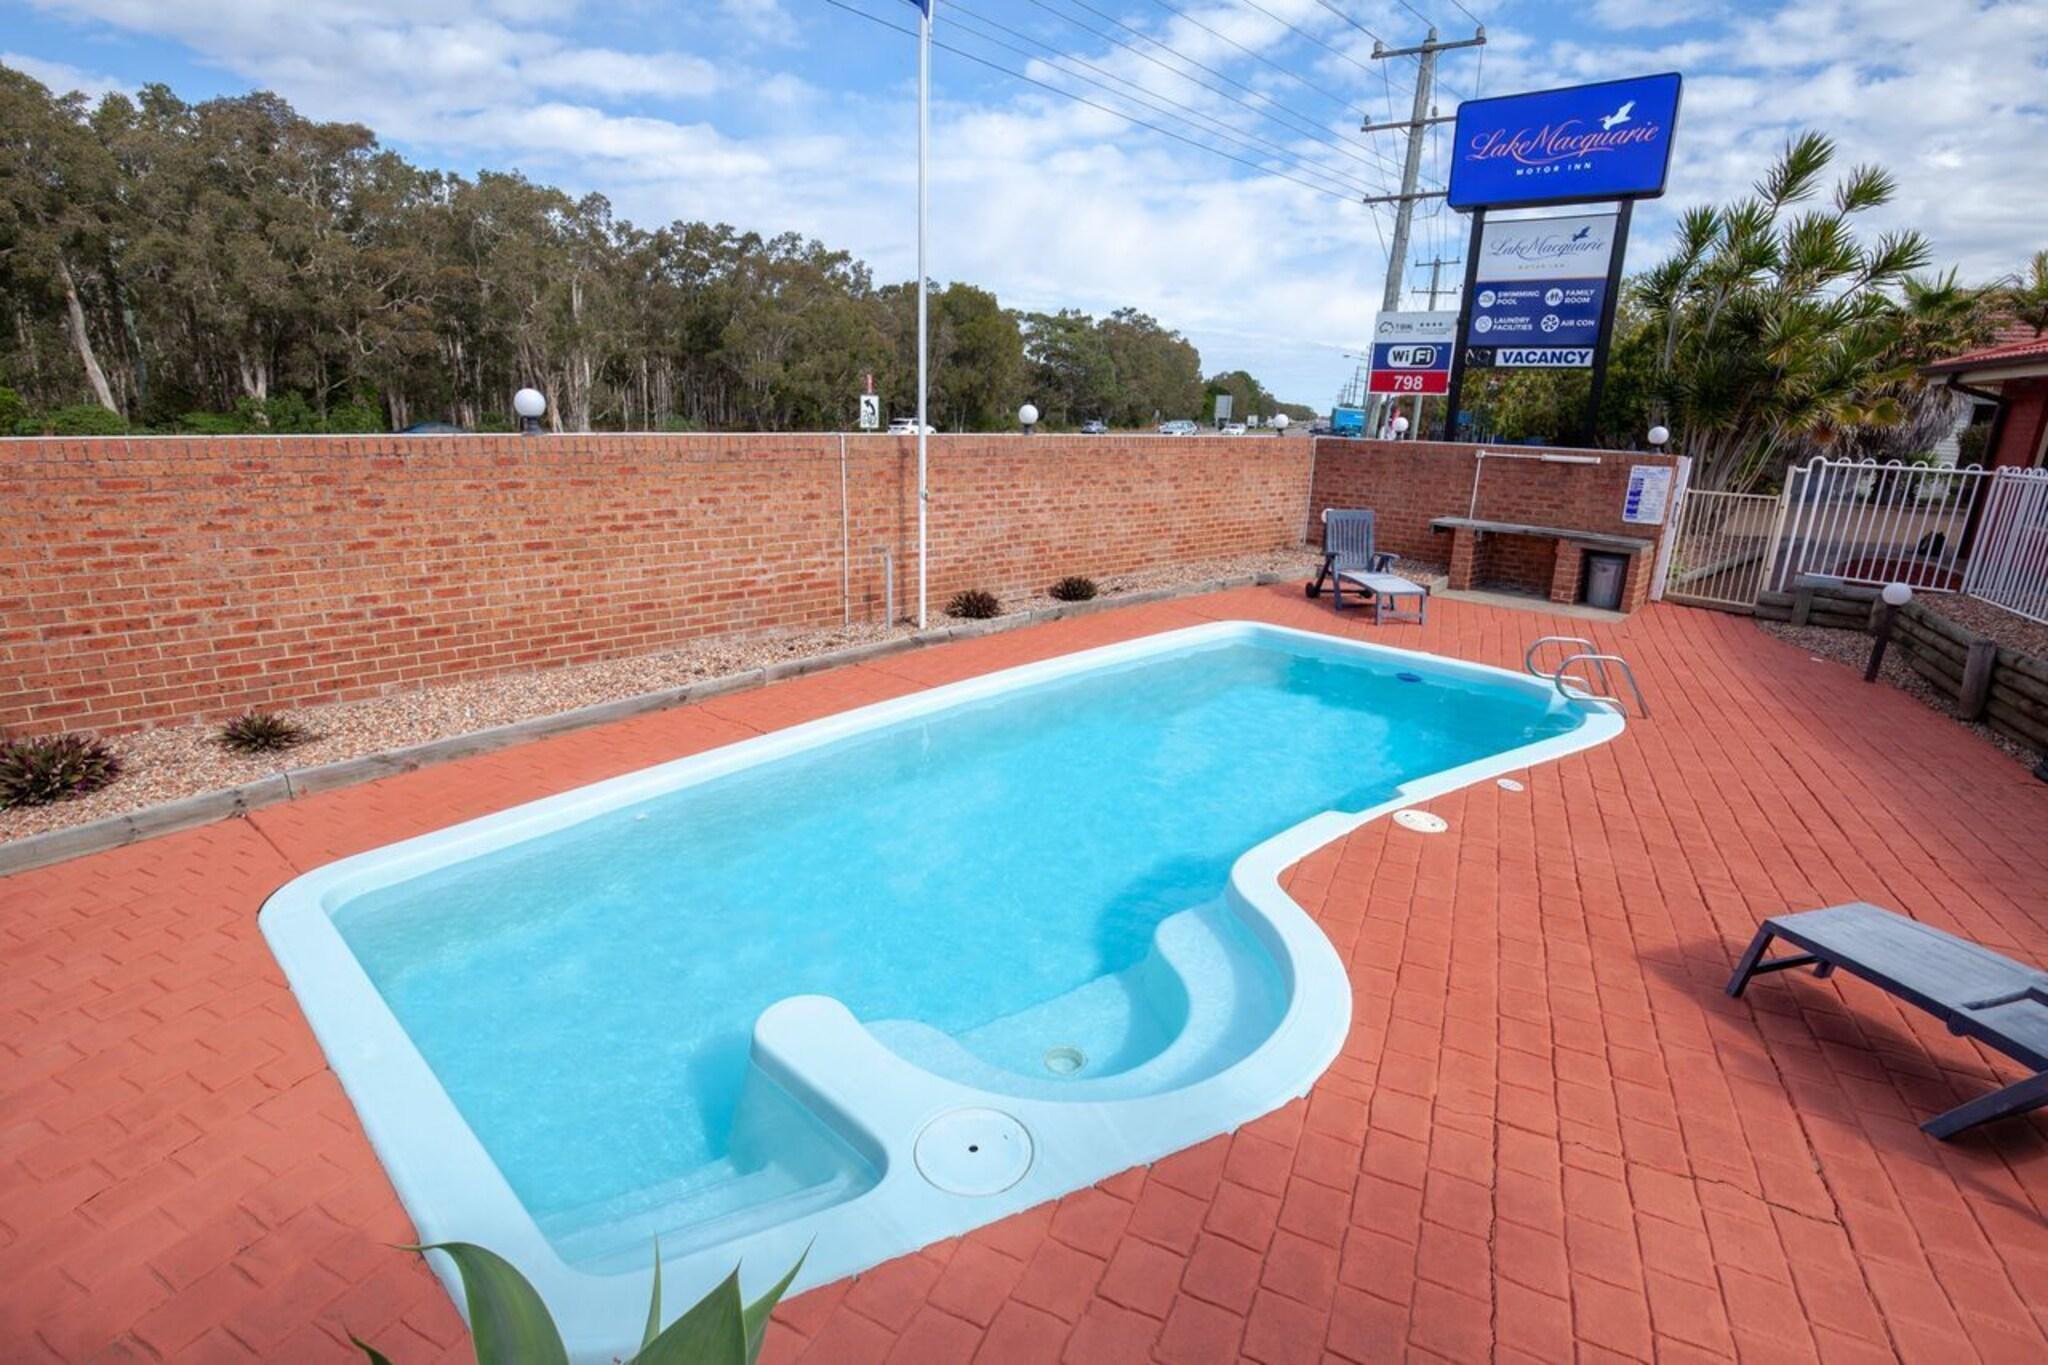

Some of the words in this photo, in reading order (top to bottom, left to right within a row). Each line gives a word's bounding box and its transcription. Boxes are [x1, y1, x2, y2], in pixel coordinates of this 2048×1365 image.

[1465, 128, 1531, 163] Lake
[1525, 120, 1660, 157] Macquarie
[1515, 165, 1560, 176] MOTOR
[1567, 161, 1592, 172] INN
[1490, 237, 1528, 258] Lake
[1523, 235, 1607, 257] Macquarie
[1498, 290, 1540, 298] SWIMMING
[1564, 296, 1591, 304] ROOM
[1492, 323, 1534, 331] FACILITIES
[1560, 319, 1576, 327] AIR
[1576, 319, 1596, 327] CON
[1501, 351, 1590, 364] VACANCY
[1393, 375, 1424, 391] 798
